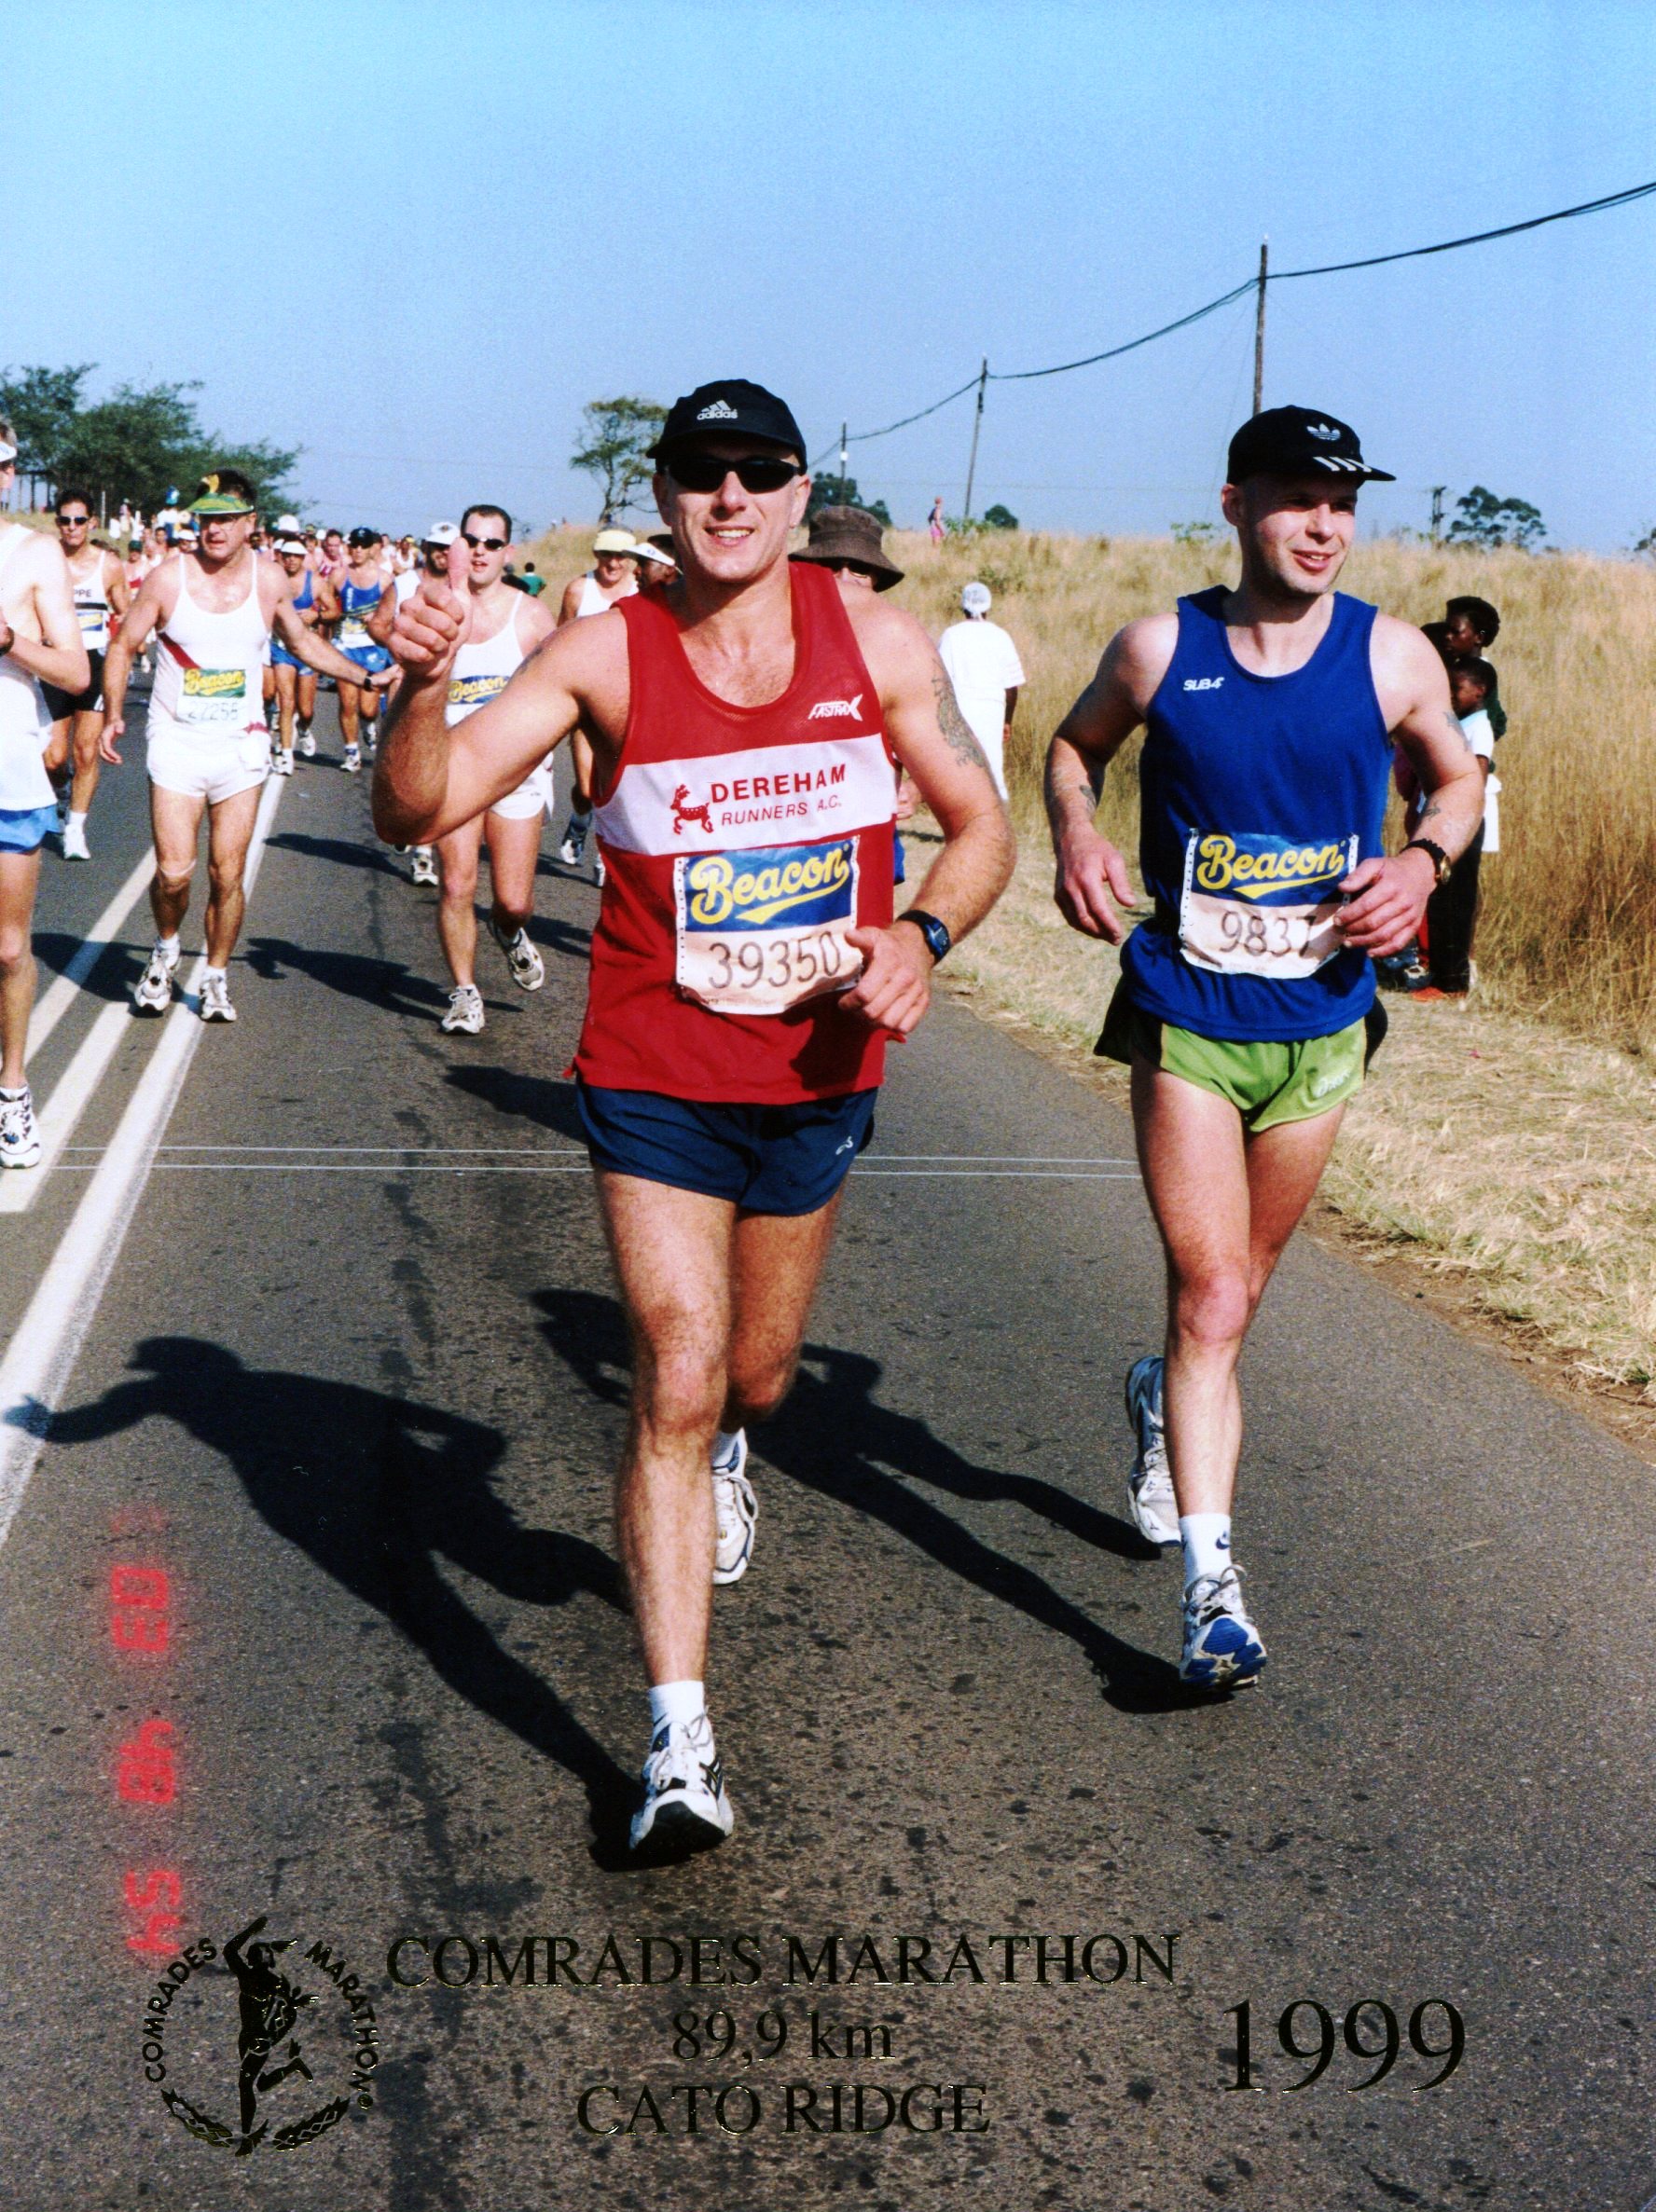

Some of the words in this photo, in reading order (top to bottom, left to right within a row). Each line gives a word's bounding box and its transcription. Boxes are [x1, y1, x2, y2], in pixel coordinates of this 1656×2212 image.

[697, 408, 738, 420] adidas
[184, 668, 245, 696] Beacon
[448, 676, 509, 703] Beacon
[711, 764, 846, 803] DEREHAM
[721, 802, 808, 826] RUNNERS
[817, 794, 842, 811] A.C.
[690, 846, 849, 925] Beacon
[1196, 834, 1345, 899] Beacon
[1219, 910, 1317, 958] 9837
[708, 930, 841, 989] 39350
